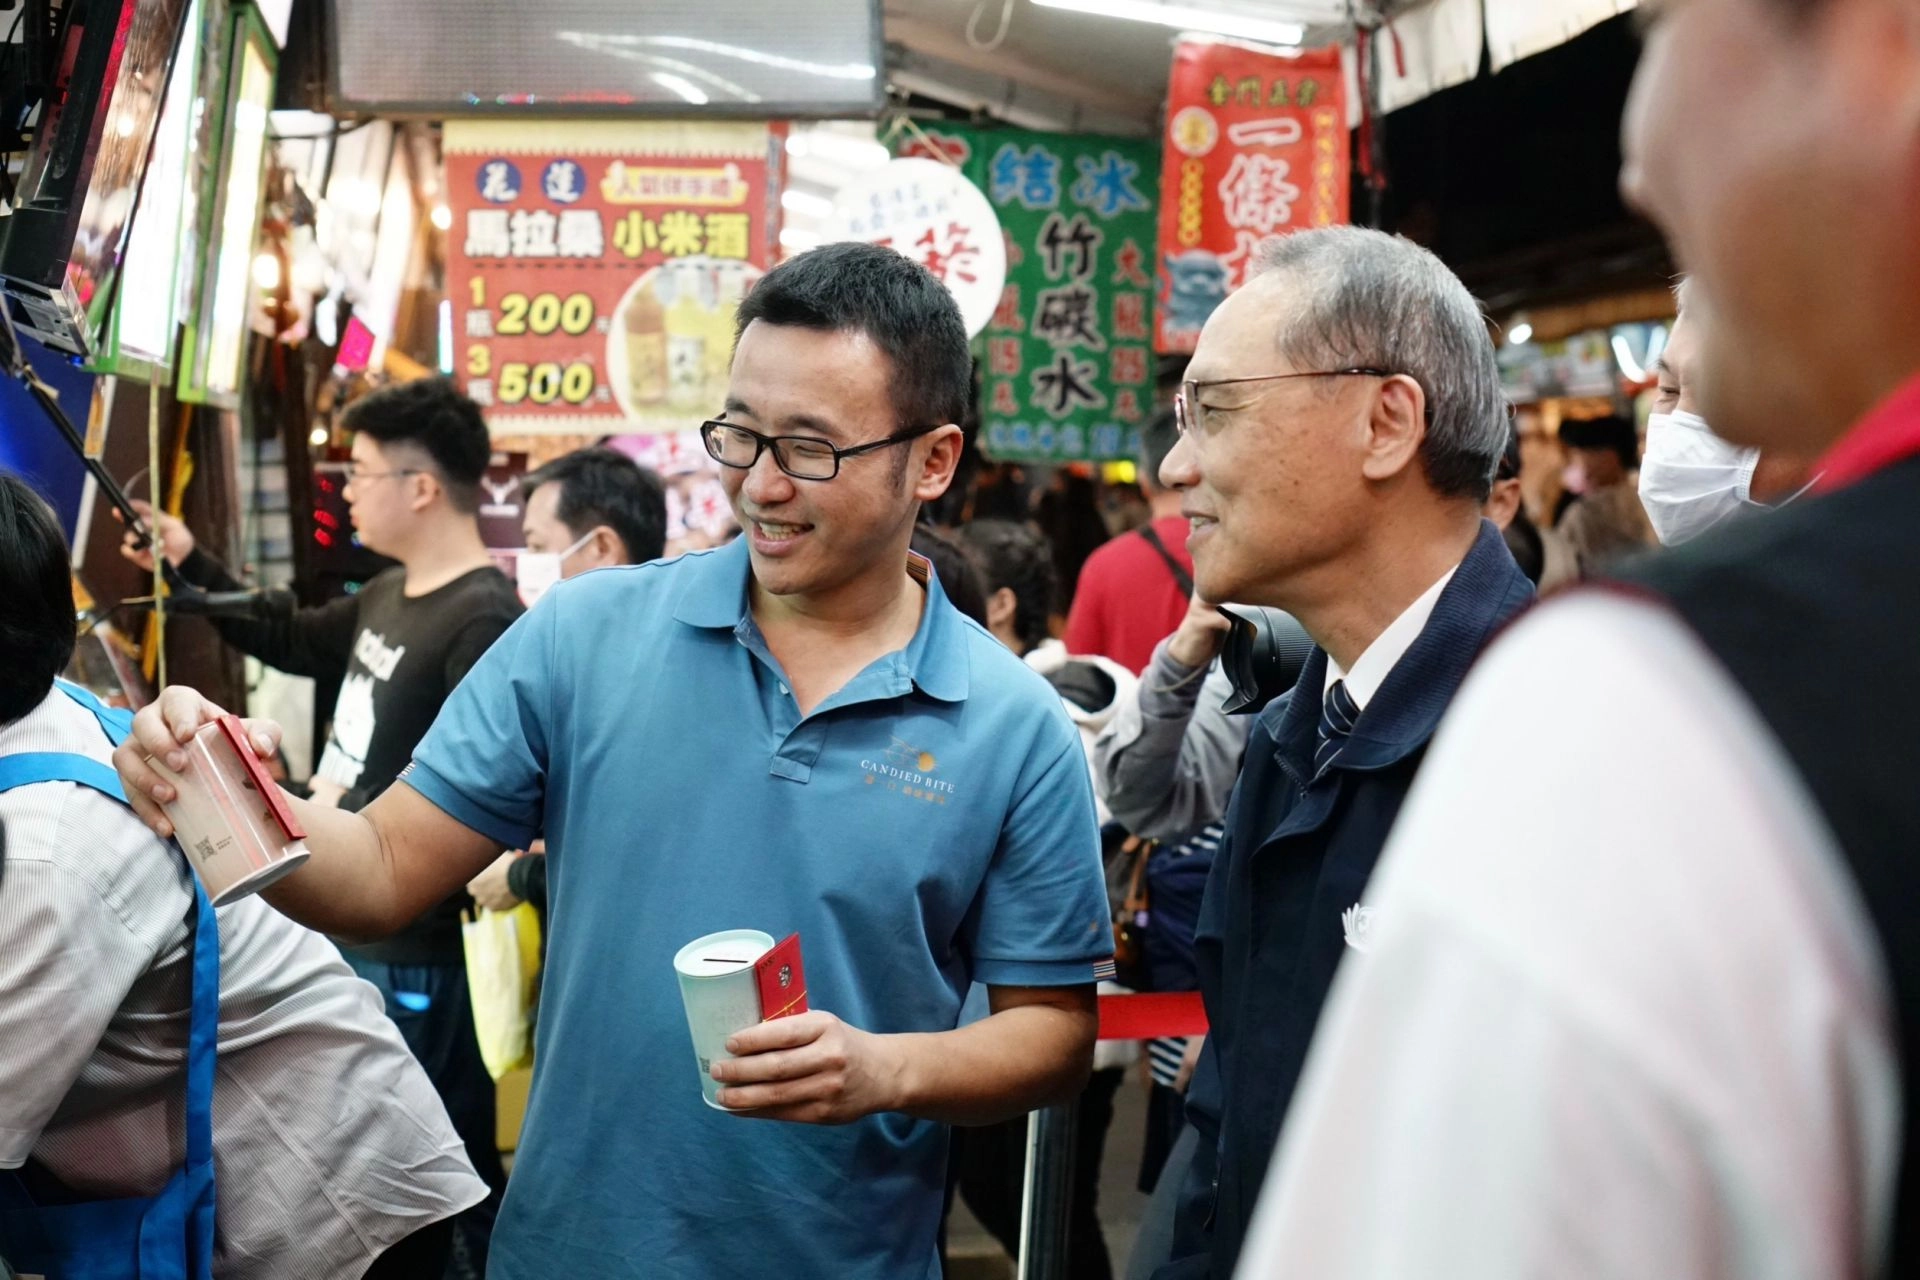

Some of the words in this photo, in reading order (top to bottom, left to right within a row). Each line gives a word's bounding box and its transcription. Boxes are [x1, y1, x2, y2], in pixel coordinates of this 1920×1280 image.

[612, 210, 749, 259] 小米酒
[496, 293, 594, 335] 200
[498, 362, 594, 404] 500
[861, 759, 922, 784] CANDIED
